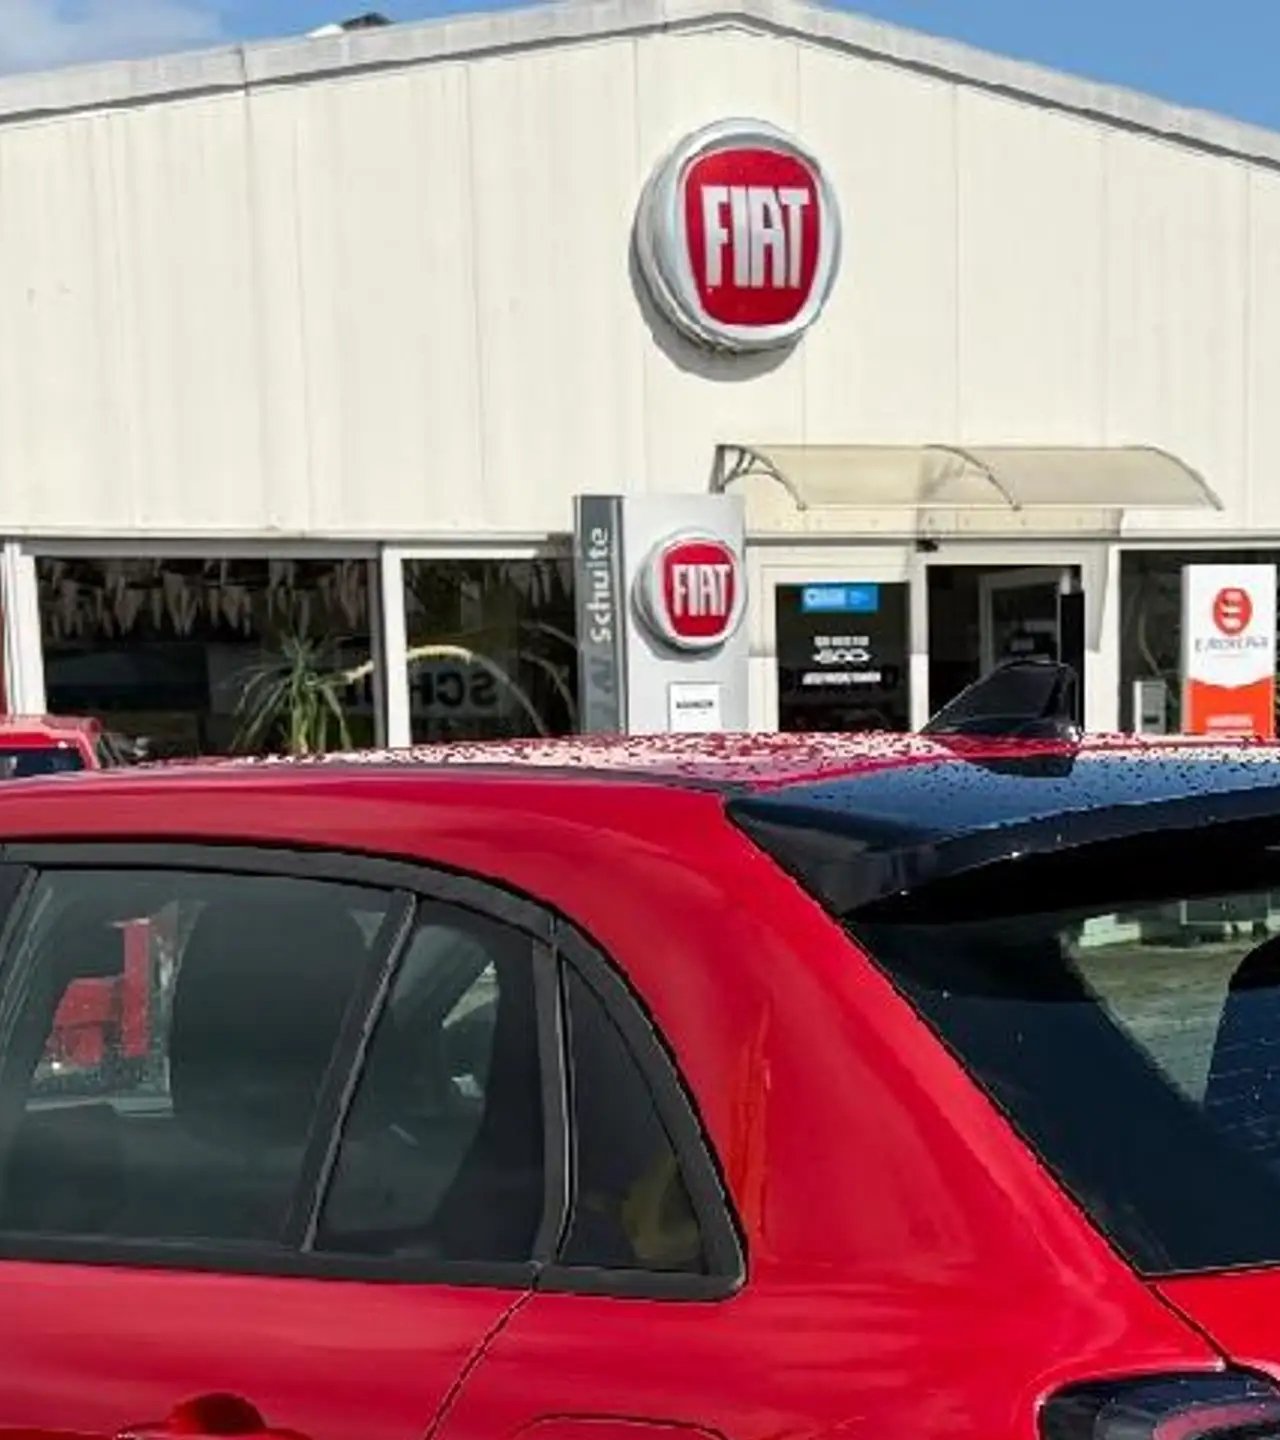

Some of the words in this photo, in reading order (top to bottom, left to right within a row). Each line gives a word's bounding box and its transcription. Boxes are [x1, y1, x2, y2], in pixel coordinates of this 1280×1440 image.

[701, 184, 811, 290] FIAT
[586, 527, 613, 643] Schulte
[671, 563, 732, 617] FIAT
